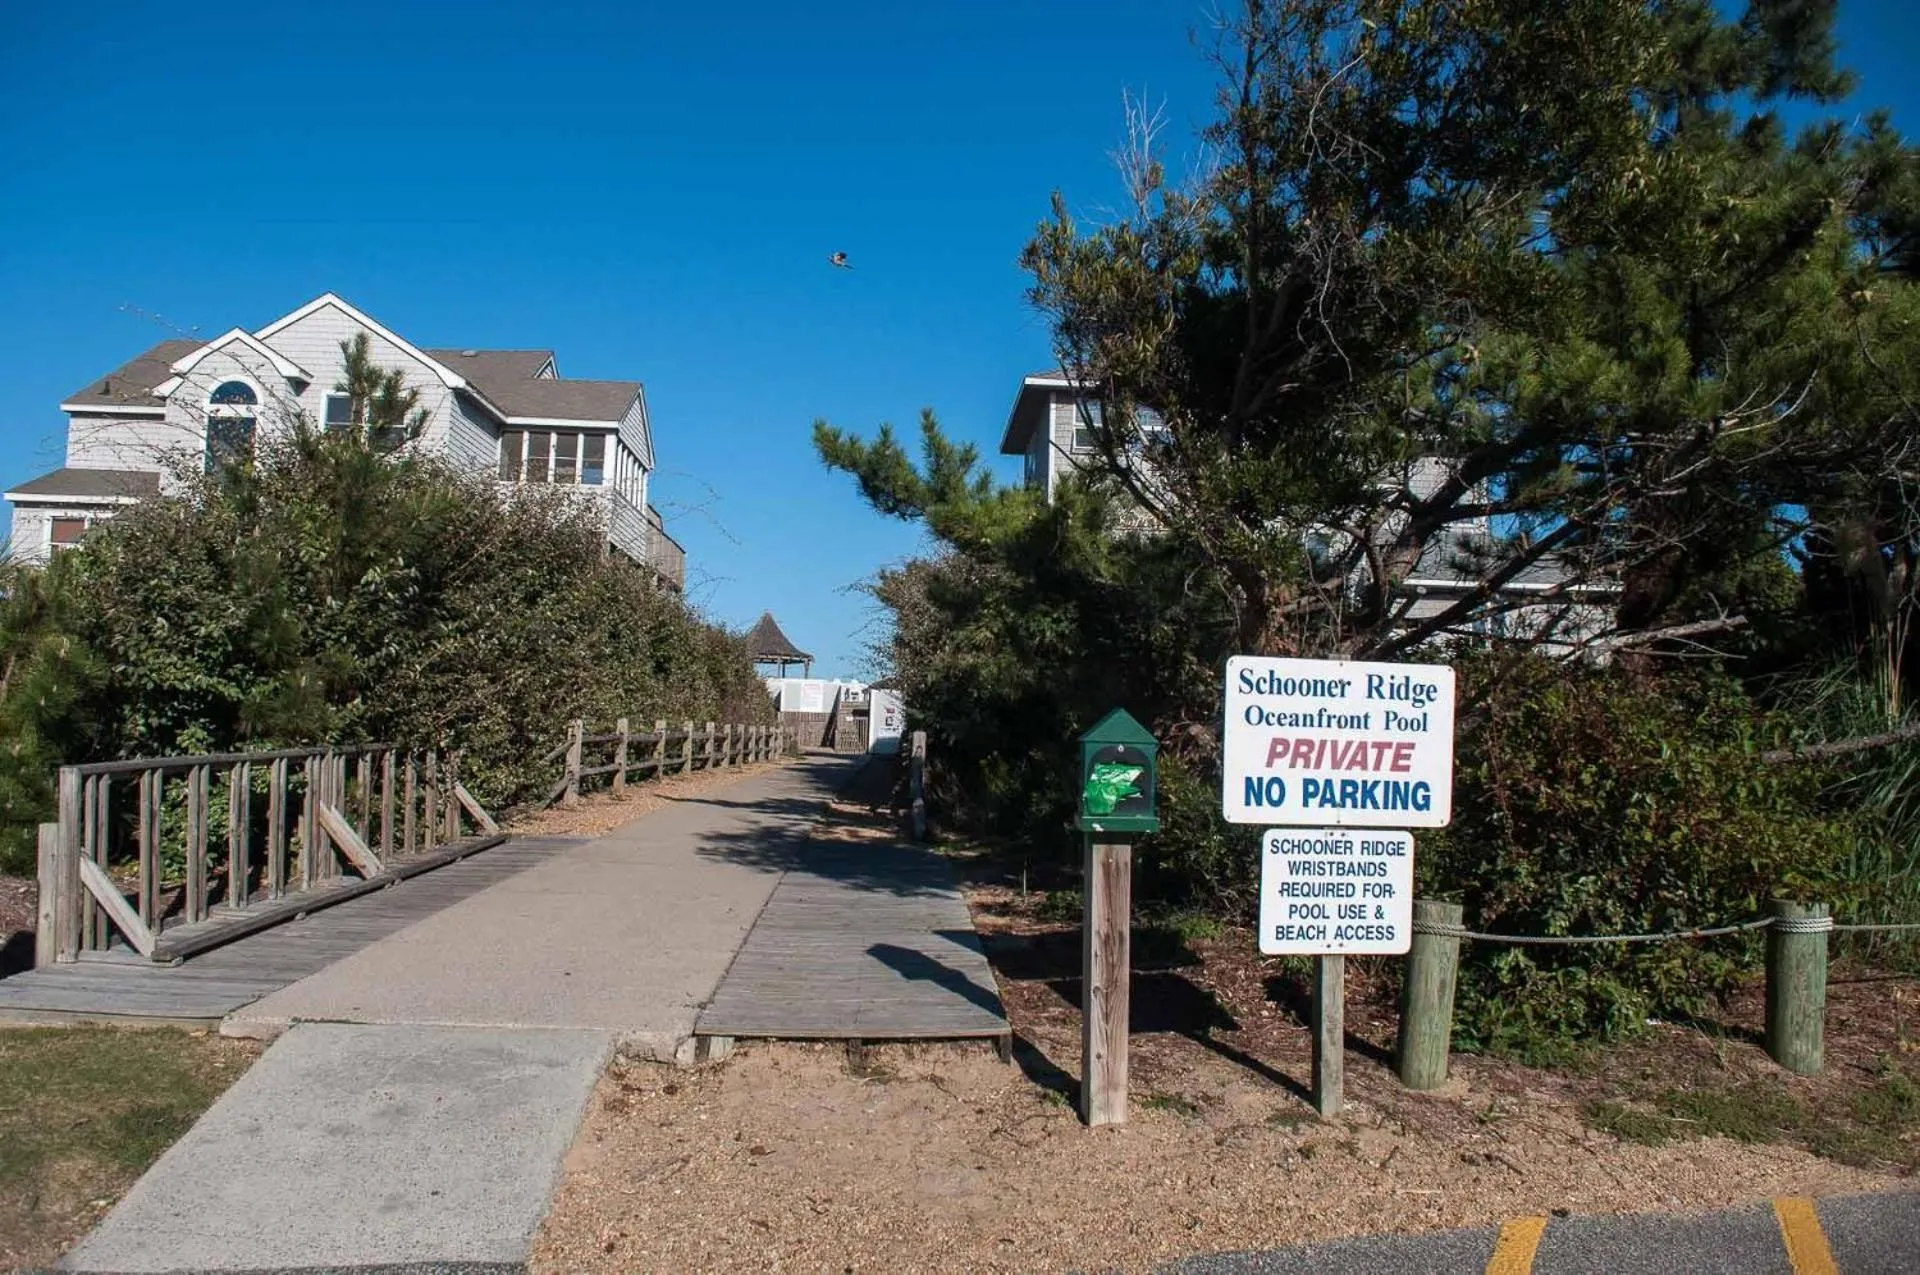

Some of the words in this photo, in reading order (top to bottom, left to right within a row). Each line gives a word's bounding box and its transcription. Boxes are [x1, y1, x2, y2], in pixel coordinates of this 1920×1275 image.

[1239, 668, 1351, 698] Schooner
[1366, 674, 1437, 708] Ridge
[1244, 705, 1371, 730] Oceanfront
[1384, 711, 1428, 732] Pool
[1265, 737, 1415, 773] PRIVATE
[1244, 777, 1286, 807] NO
[1303, 778, 1431, 811] PARKING
[1270, 840, 1353, 856] SCHOONER
[1361, 841, 1406, 856] RIDGE
[1288, 861, 1387, 877] WRISTBANDS
[1280, 882, 1355, 898] REQUIRED
[1362, 883, 1393, 898] FOR
[1289, 905, 1330, 919] POOL
[1338, 905, 1367, 919] USE
[1375, 906, 1384, 919] &
[1276, 925, 1326, 940] BEACH
[1334, 925, 1394, 941] ACCESS
